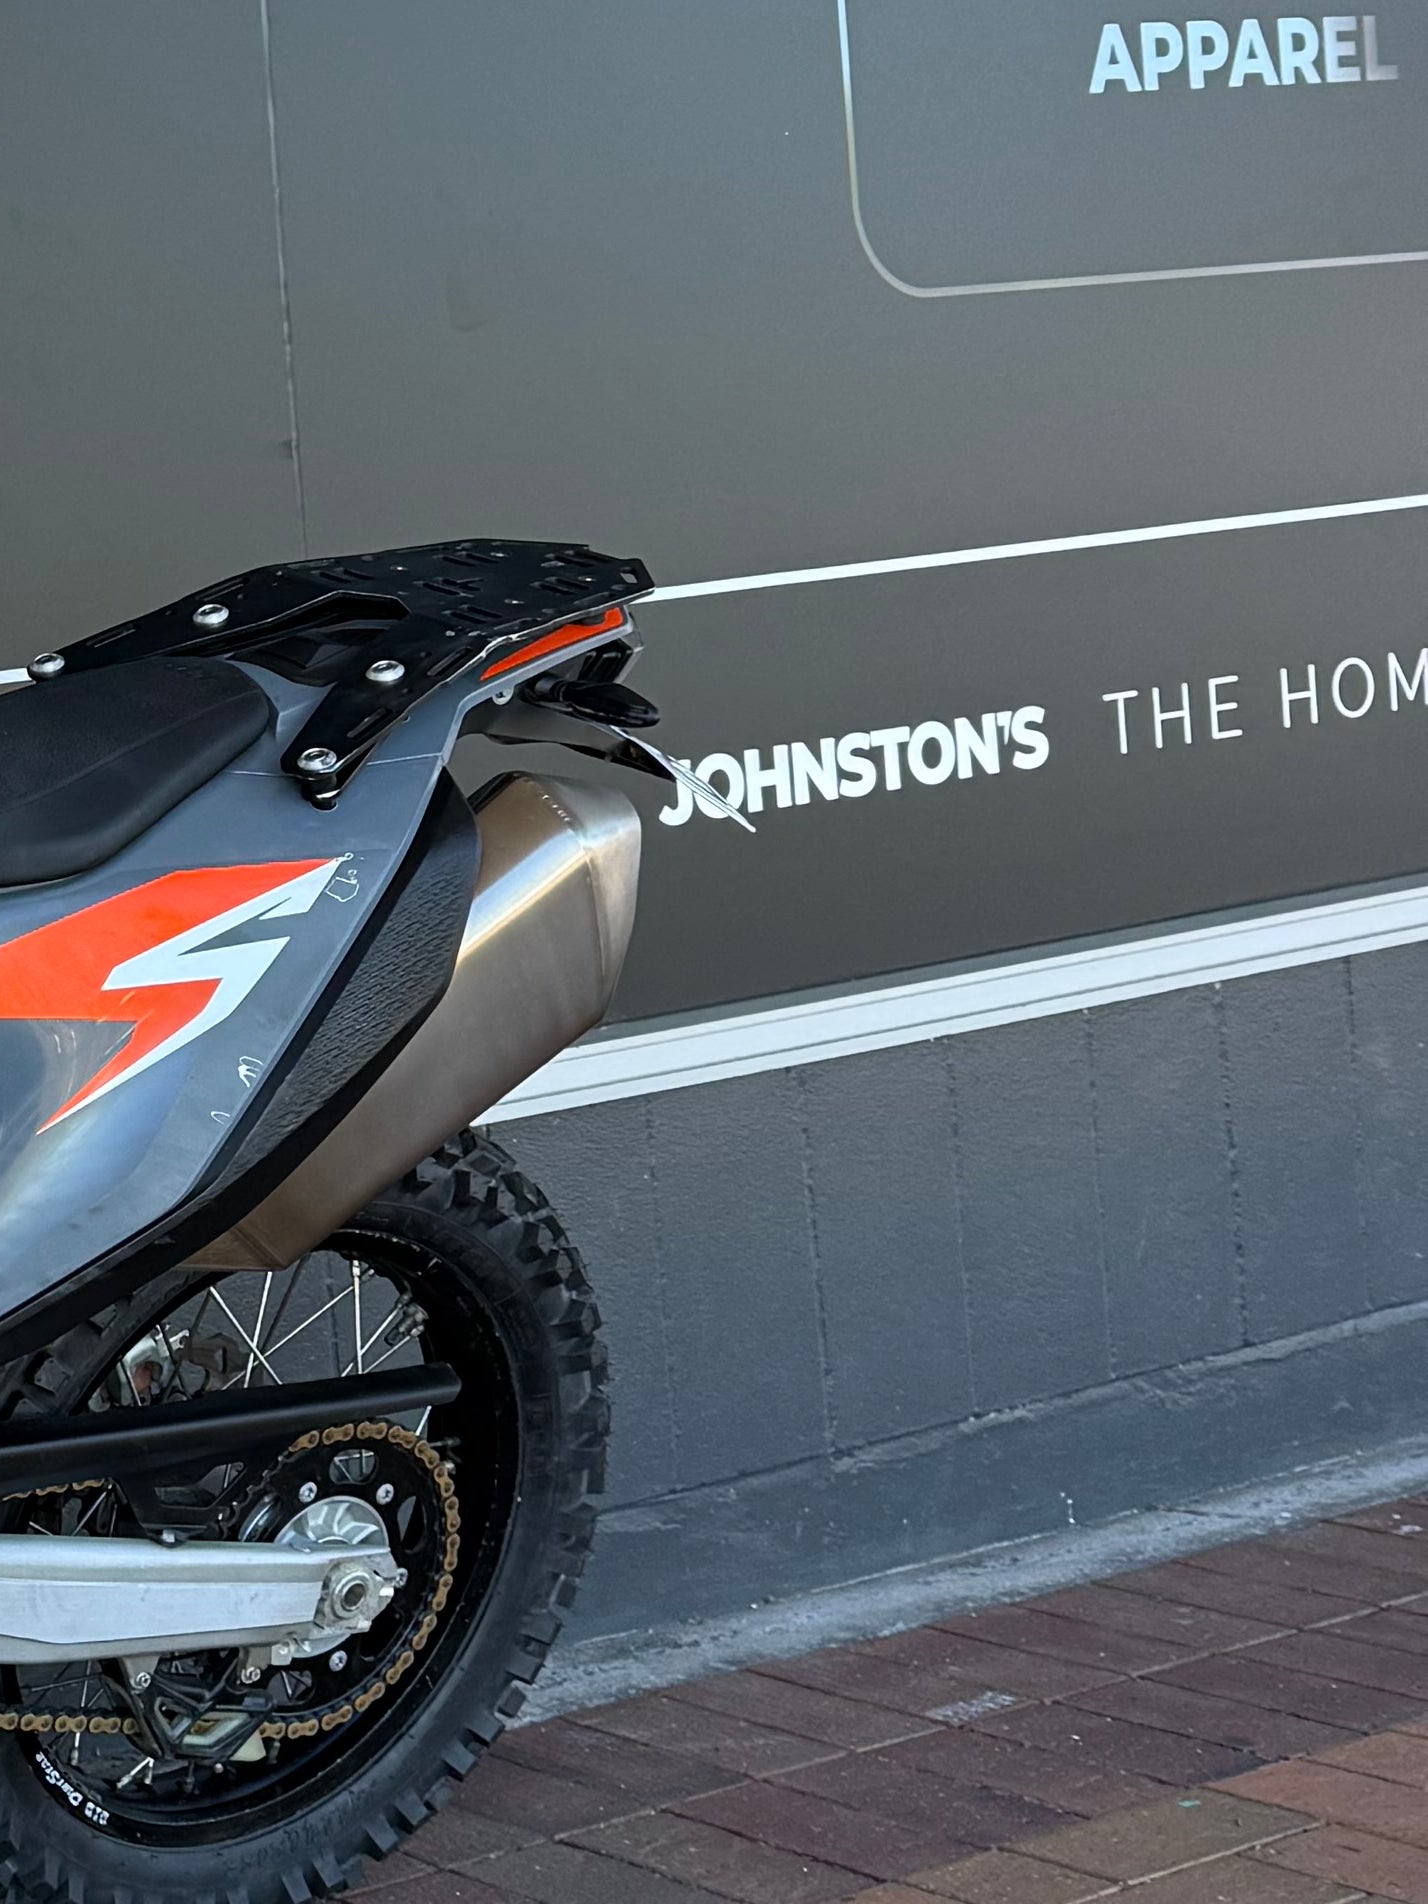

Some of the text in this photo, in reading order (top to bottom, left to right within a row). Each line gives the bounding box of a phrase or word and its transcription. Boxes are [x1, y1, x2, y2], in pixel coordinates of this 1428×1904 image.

[1088, 14, 1398, 94] APPAREL
[658, 705, 1050, 827] JOHNSTON'S
[1102, 674, 1245, 756] THE
